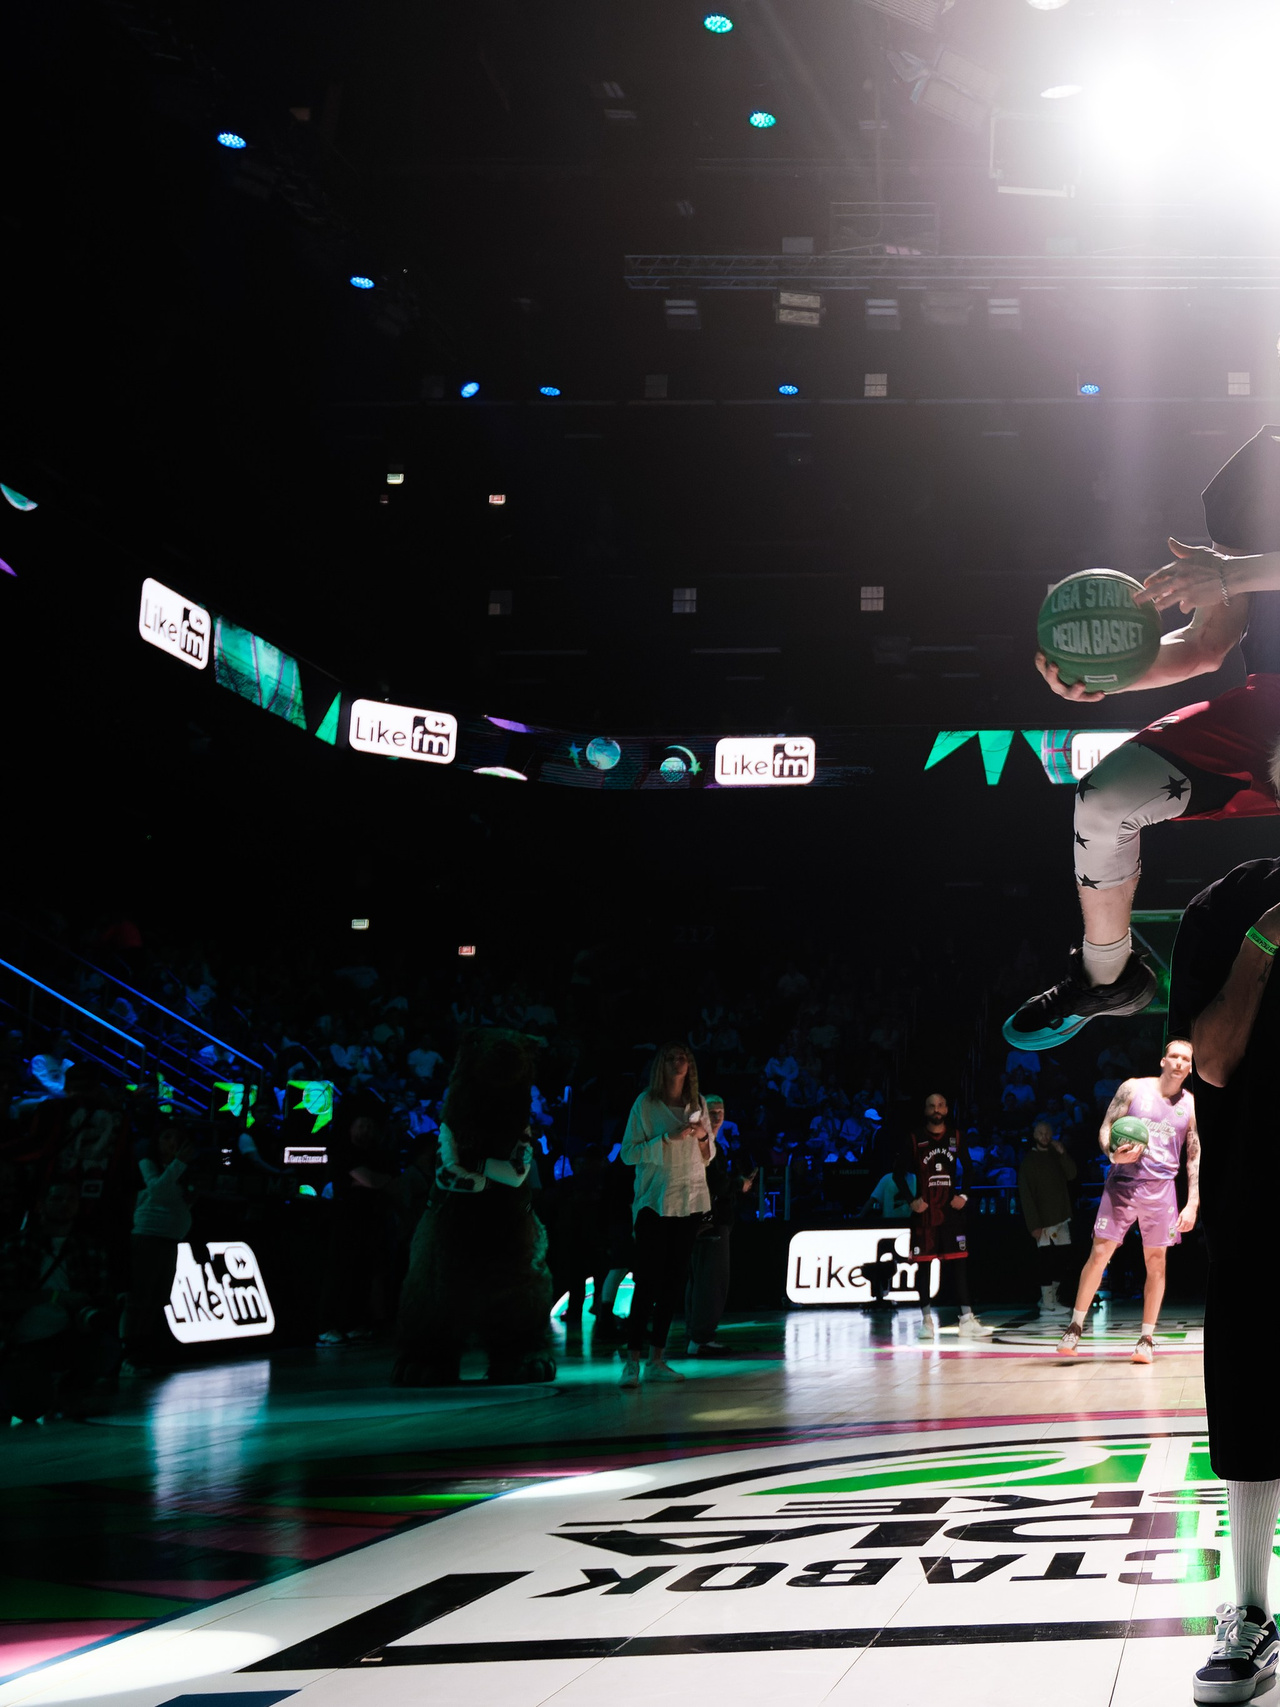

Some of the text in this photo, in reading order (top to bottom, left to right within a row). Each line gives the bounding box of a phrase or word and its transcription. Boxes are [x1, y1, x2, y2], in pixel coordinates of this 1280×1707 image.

[144, 598, 178, 643] Like
[1052, 618, 1143, 655] MEDIA BASKET
[355, 716, 449, 756] Like fm
[720, 752, 809, 778] Like fm
[795, 1255, 867, 1289] Like
[170, 1273, 267, 1323] Like fm
[529, 1548, 1222, 1599] СТАВОК
